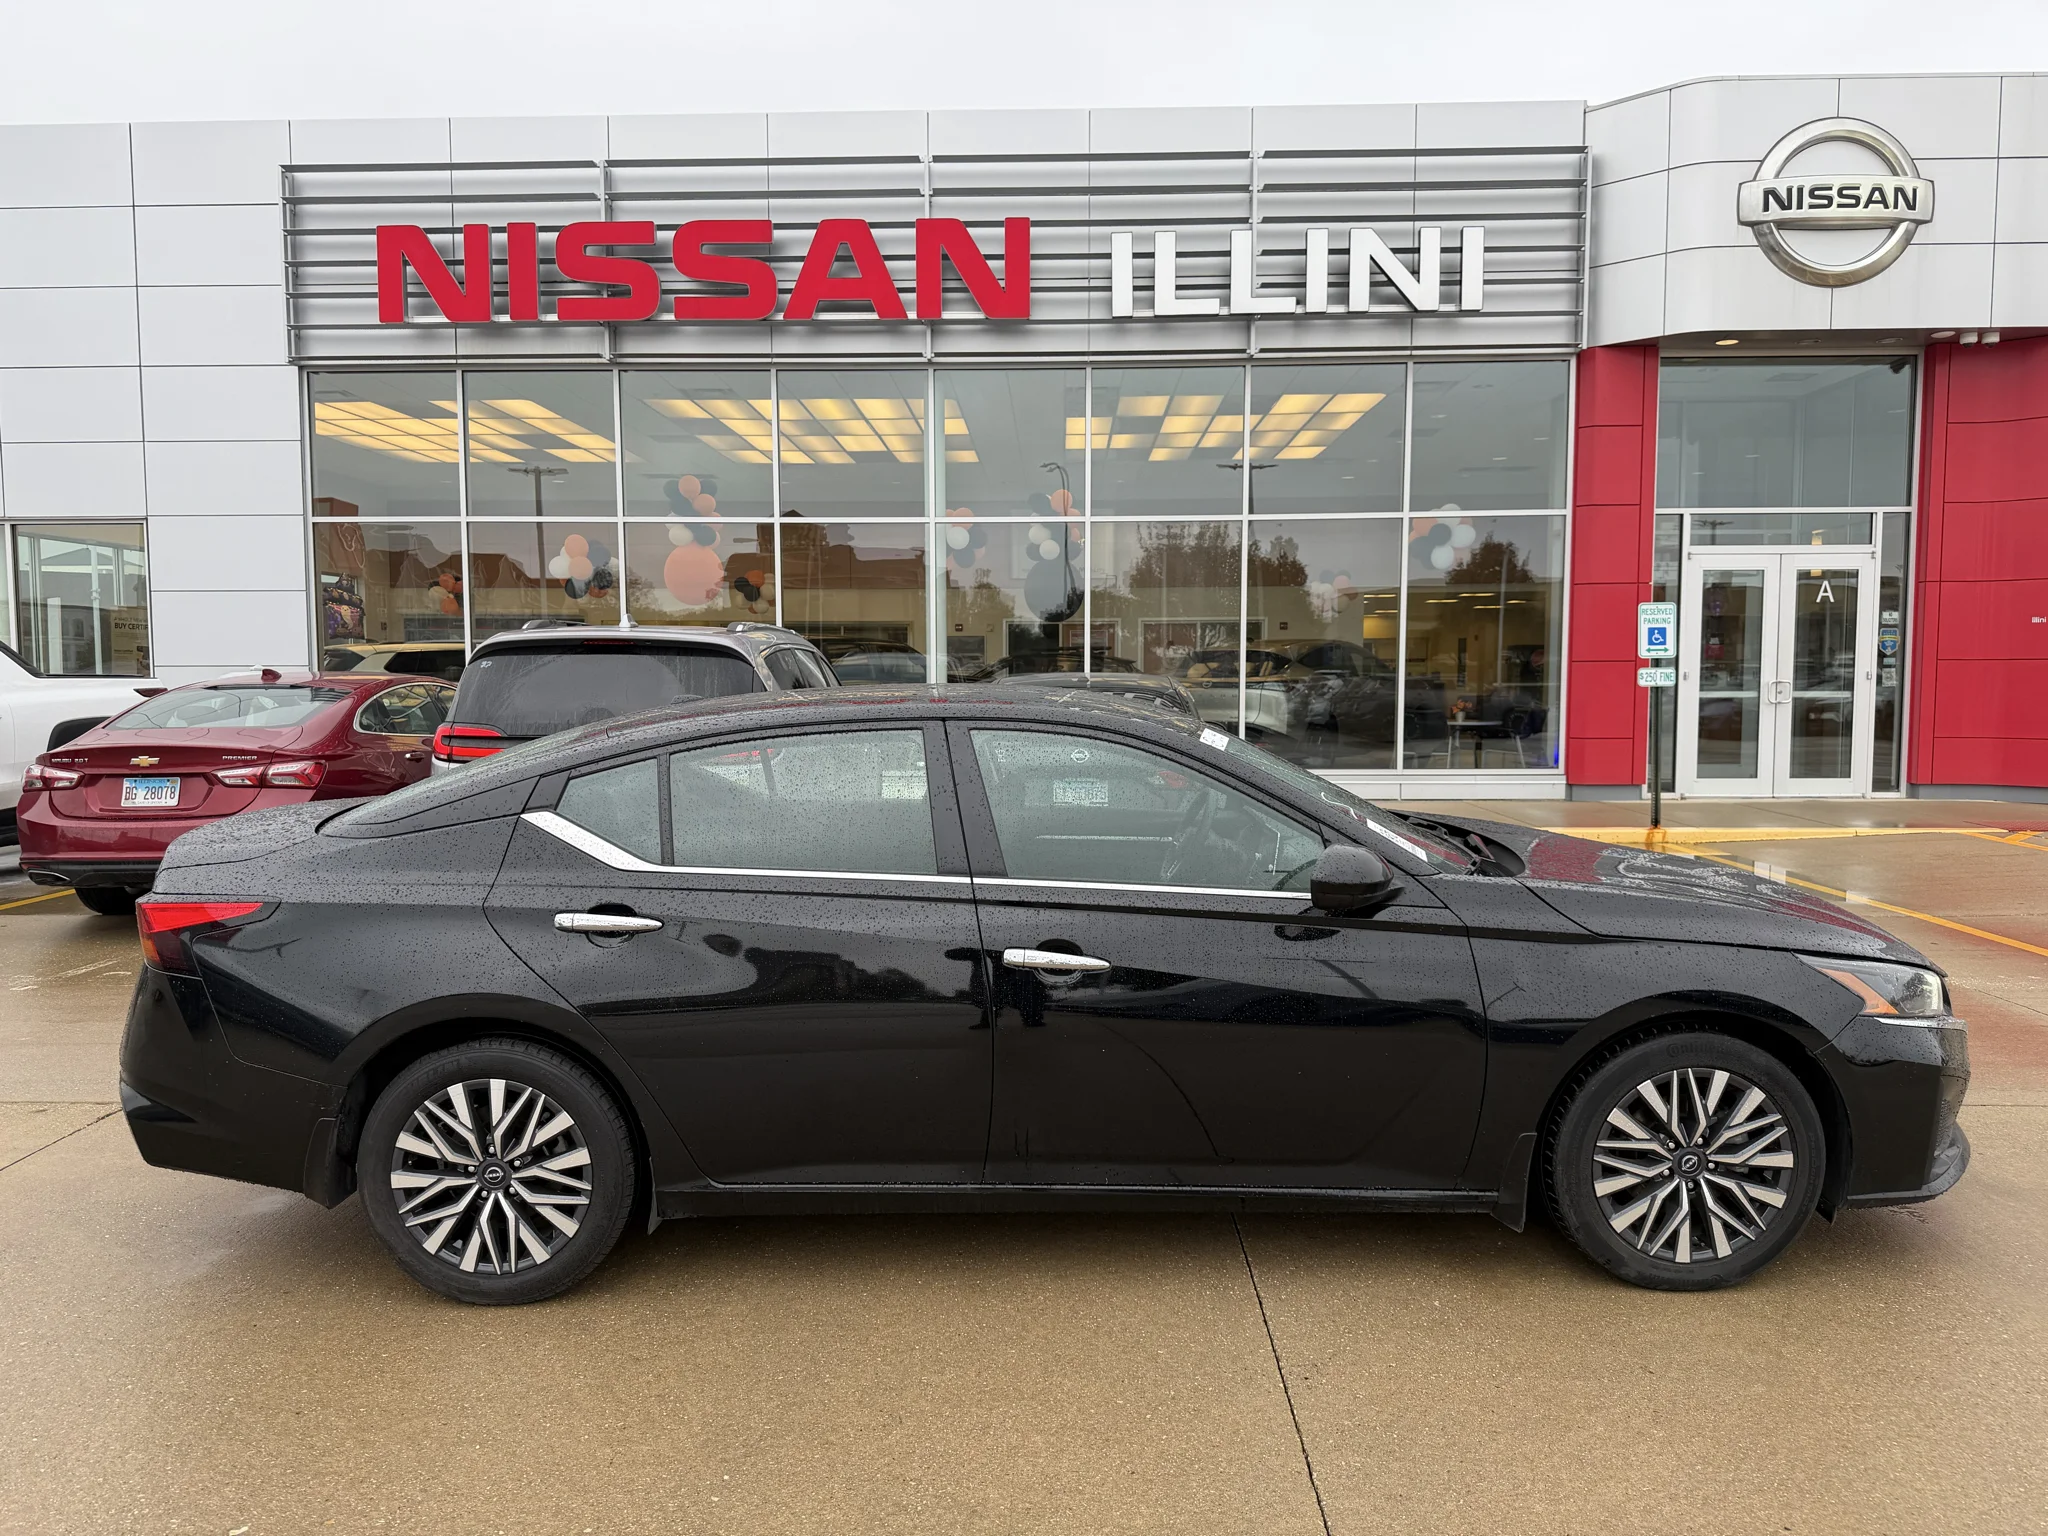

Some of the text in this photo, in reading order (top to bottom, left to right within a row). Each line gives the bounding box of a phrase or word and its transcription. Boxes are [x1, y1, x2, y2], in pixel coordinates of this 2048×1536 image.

[1762, 183, 1919, 213] NISSAN
[376, 216, 1485, 323] NISSAN ILLINI
[1816, 580, 1835, 603] A
[1641, 607, 1673, 615] RESERVED
[1643, 617, 1672, 625] PARKING
[1639, 671, 1675, 682] $250 FINE
[124, 785, 176, 801] BG 28078
